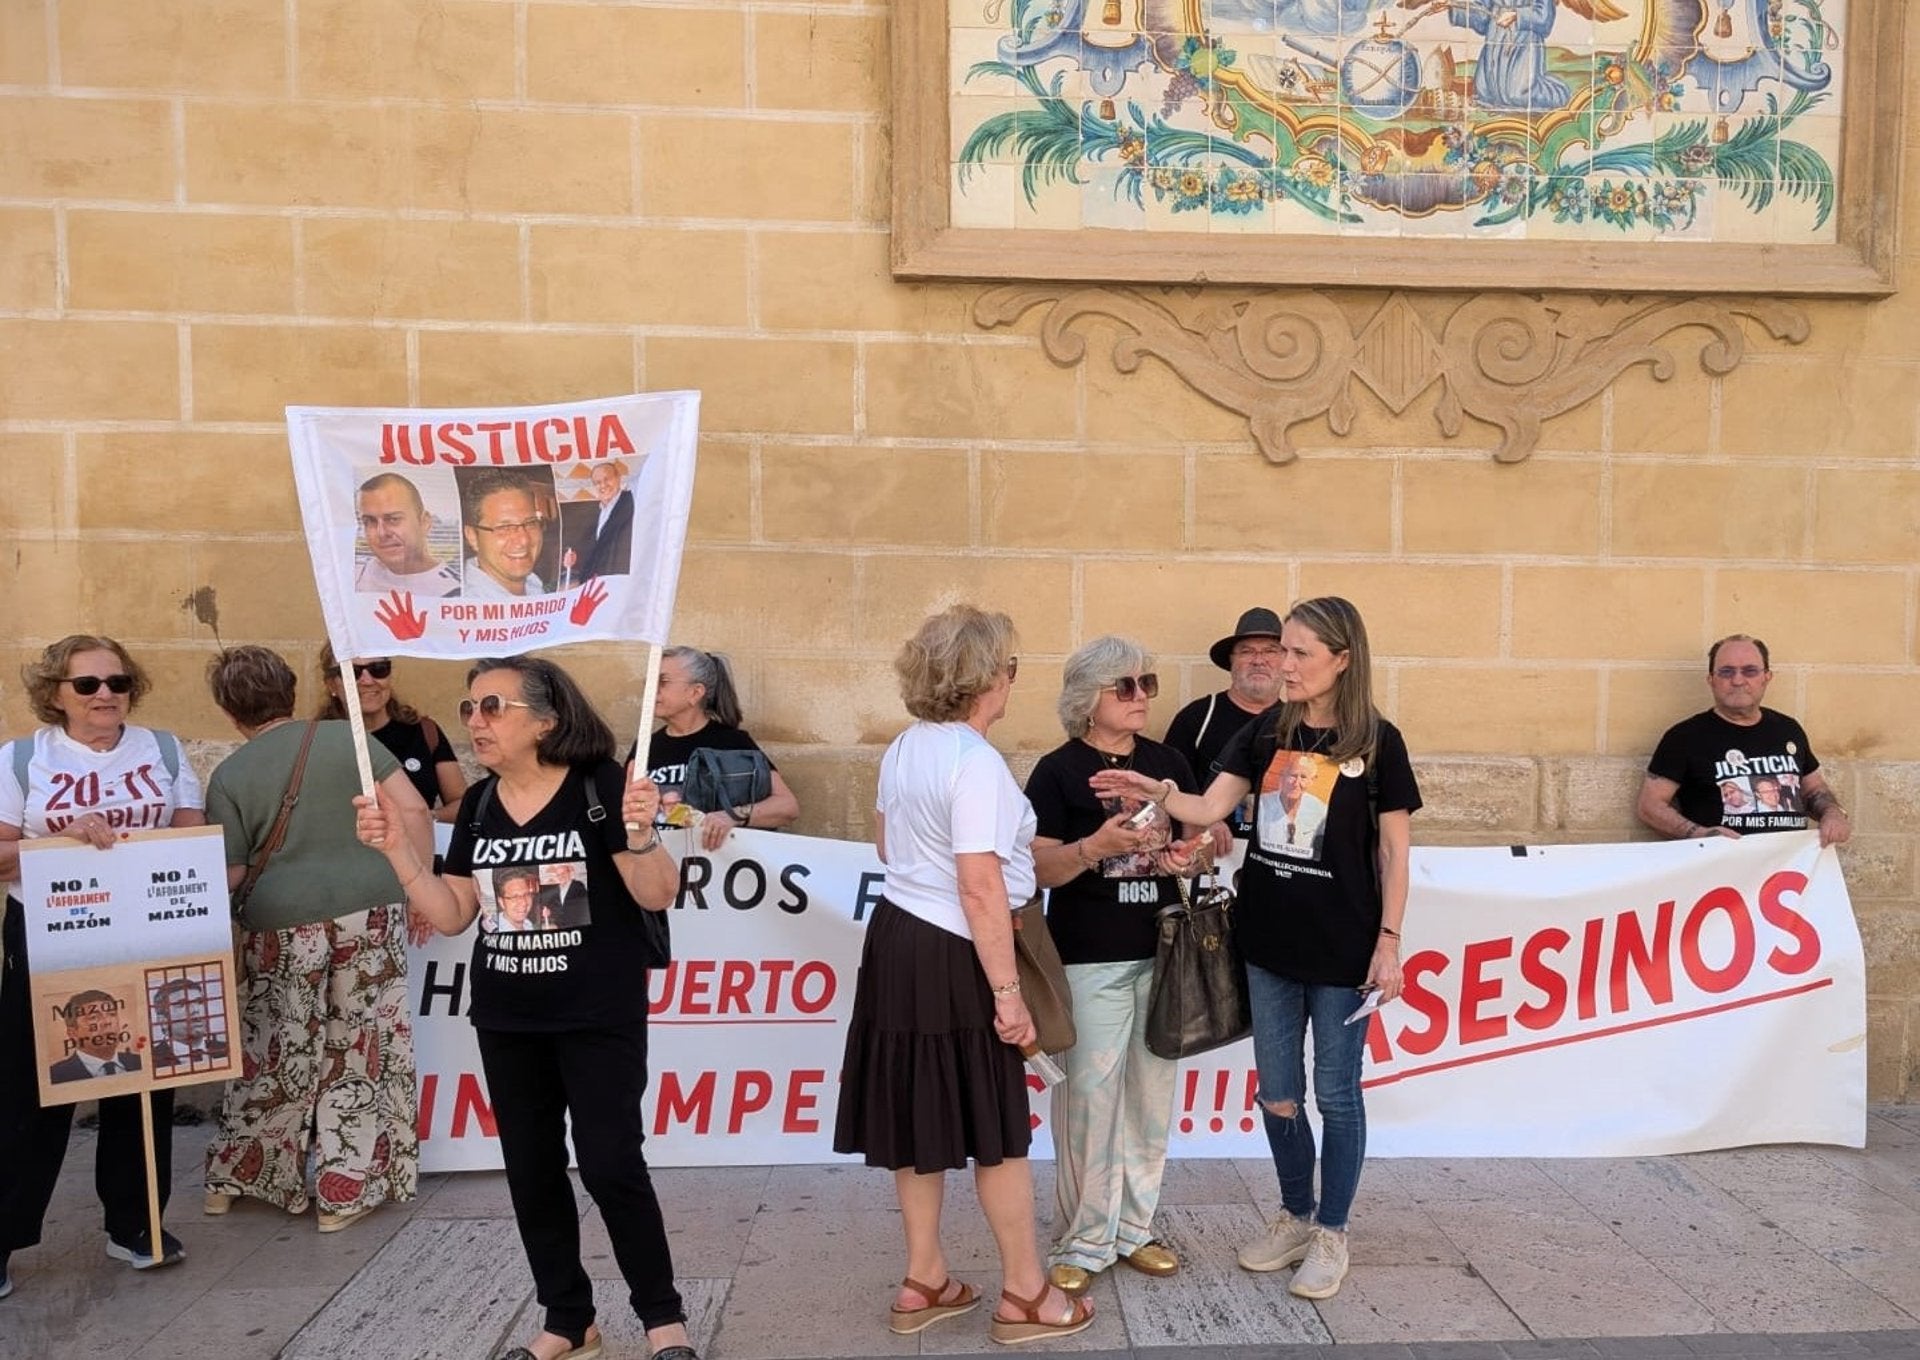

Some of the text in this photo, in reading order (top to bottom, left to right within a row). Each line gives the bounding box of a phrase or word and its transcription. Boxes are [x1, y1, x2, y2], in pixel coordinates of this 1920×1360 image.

[379, 414, 636, 466] JUSTICIA
[440, 597, 566, 621] POR MI MARIDO
[458, 620, 550, 644] Y MIS HIJOS
[94, 803, 166, 828] BLIT
[1720, 815, 1743, 827] POR
[1745, 816, 1766, 827] MIS
[472, 830, 587, 864] USTICIA
[51, 878, 99, 893] NO A
[152, 868, 197, 884] NO A
[46, 892, 111, 908] L'AFORAMENT
[147, 882, 208, 898] L'AFORAMENT
[1118, 881, 1159, 903] ROSA
[70, 907, 88, 916] DE
[170, 897, 187, 906] DE
[149, 902, 209, 922] MAZÓN
[47, 913, 111, 932] MAZÓN
[517, 929, 582, 951] MARIDO
[486, 954, 568, 974] Y MIS HIJOS
[647, 960, 838, 1015] UERTO
[64, 1023, 131, 1056] presó
